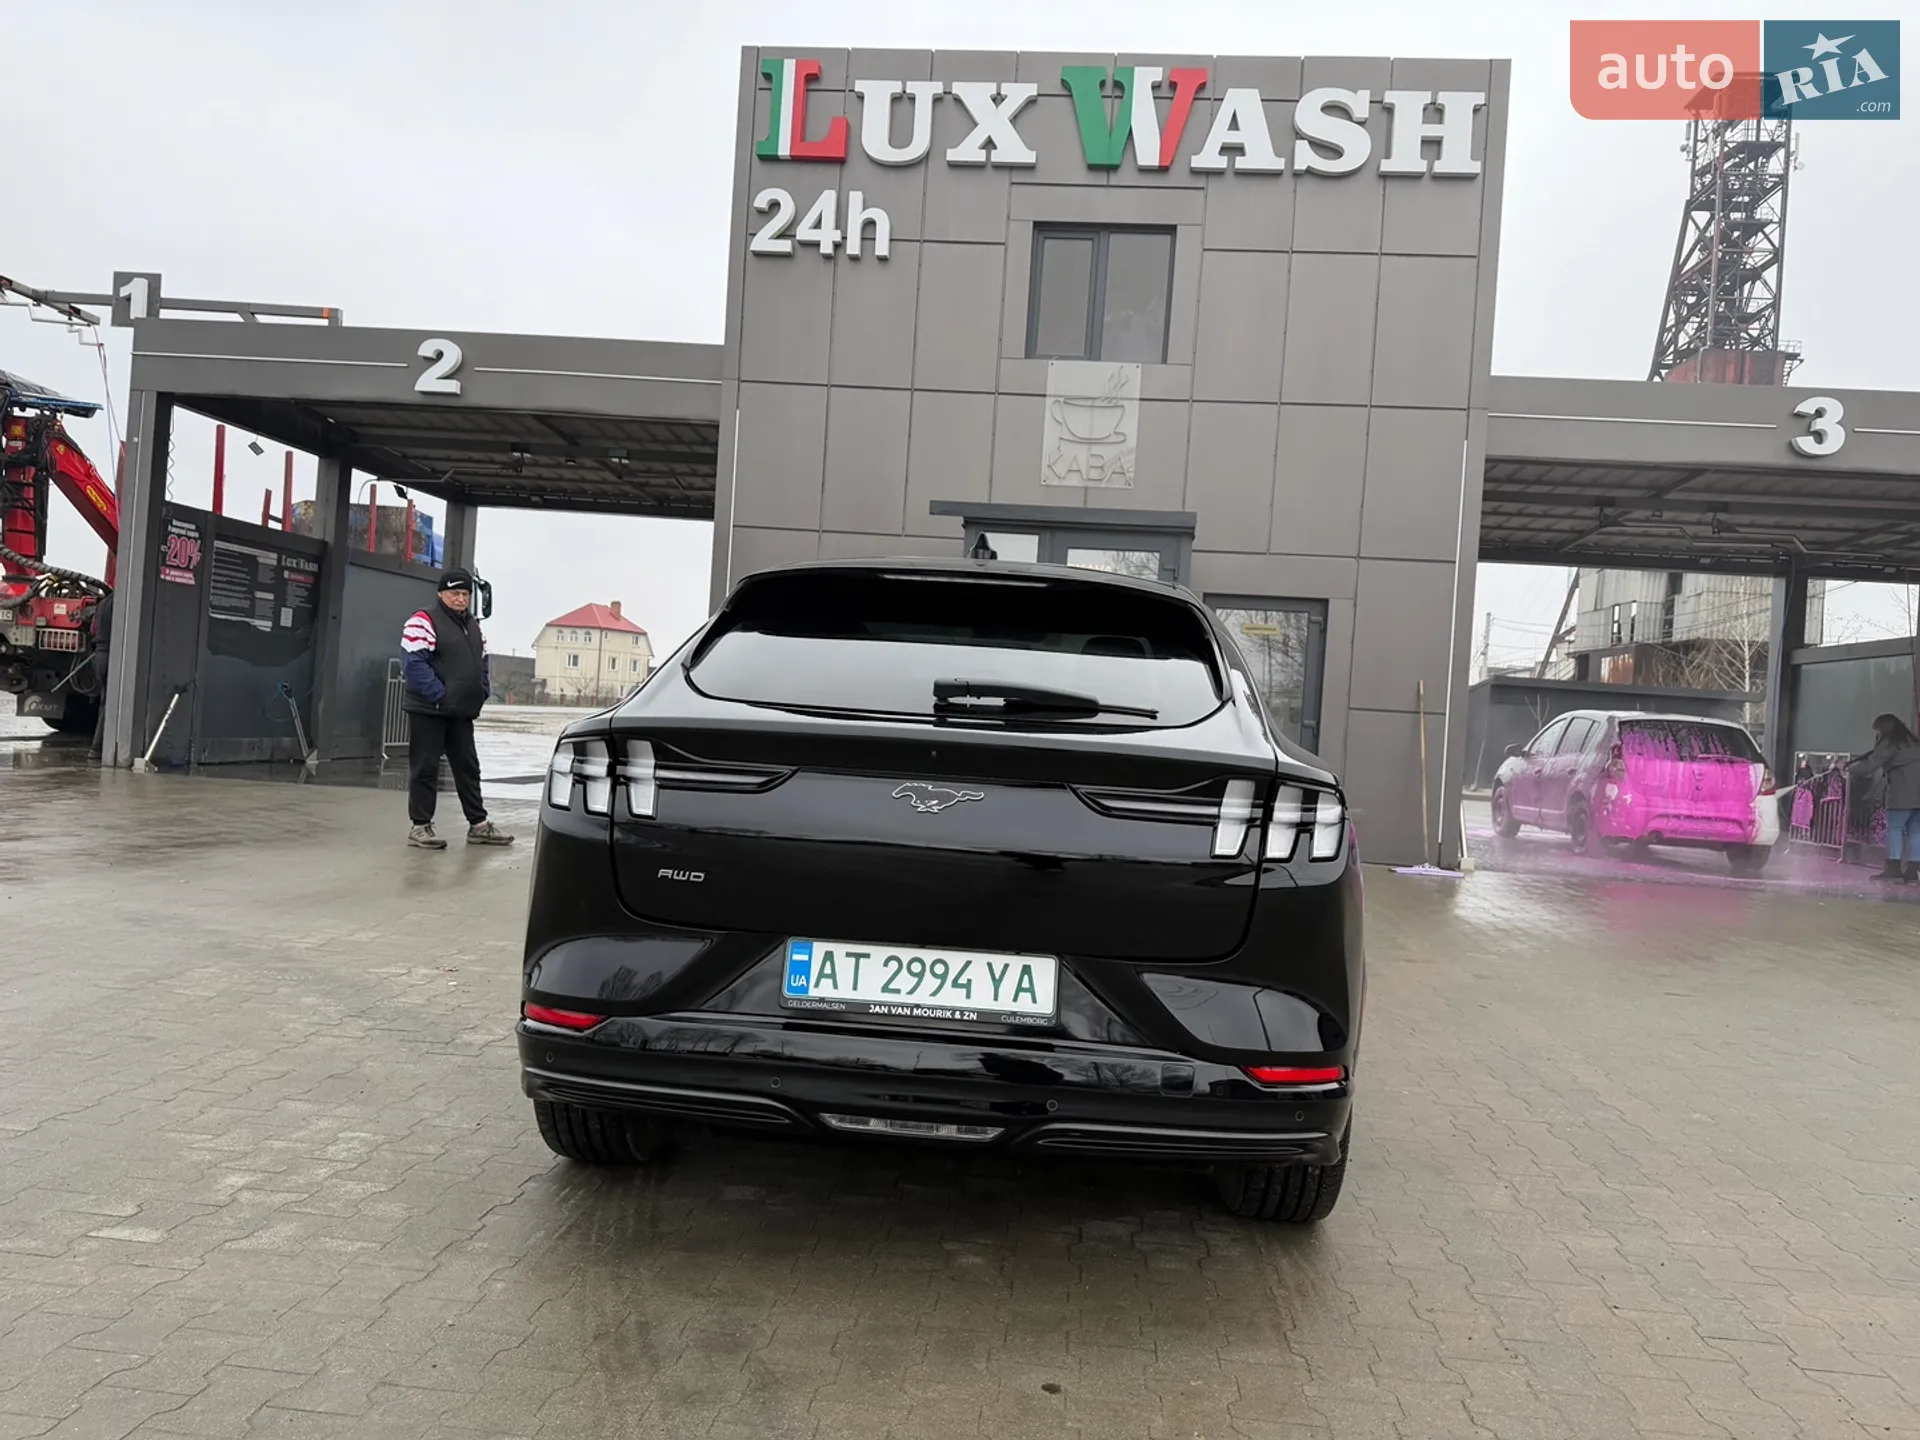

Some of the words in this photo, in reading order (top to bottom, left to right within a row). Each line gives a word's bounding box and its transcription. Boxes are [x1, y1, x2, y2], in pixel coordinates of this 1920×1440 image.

[755, 58, 1038, 167] LUX
[1061, 65, 1486, 177] WASH
[749, 188, 891, 259] 24h
[119, 277, 149, 319] 1
[413, 338, 463, 395] 2
[1790, 396, 1846, 457] 3
[657, 868, 706, 882] AWD
[790, 975, 808, 987] UA
[813, 949, 871, 992] AT
[880, 954, 974, 1000] 2994
[986, 961, 1038, 1005] YA
[788, 1000, 846, 1010] GELDERMALSEN
[868, 1004, 888, 1014] JAN
[890, 1006, 911, 1016] VAN
[912, 1007, 953, 1019] MOURIK
[954, 1010, 961, 1019] &
[963, 1011, 978, 1021] ZN
[1001, 1014, 1048, 1025] CULEMBORG
